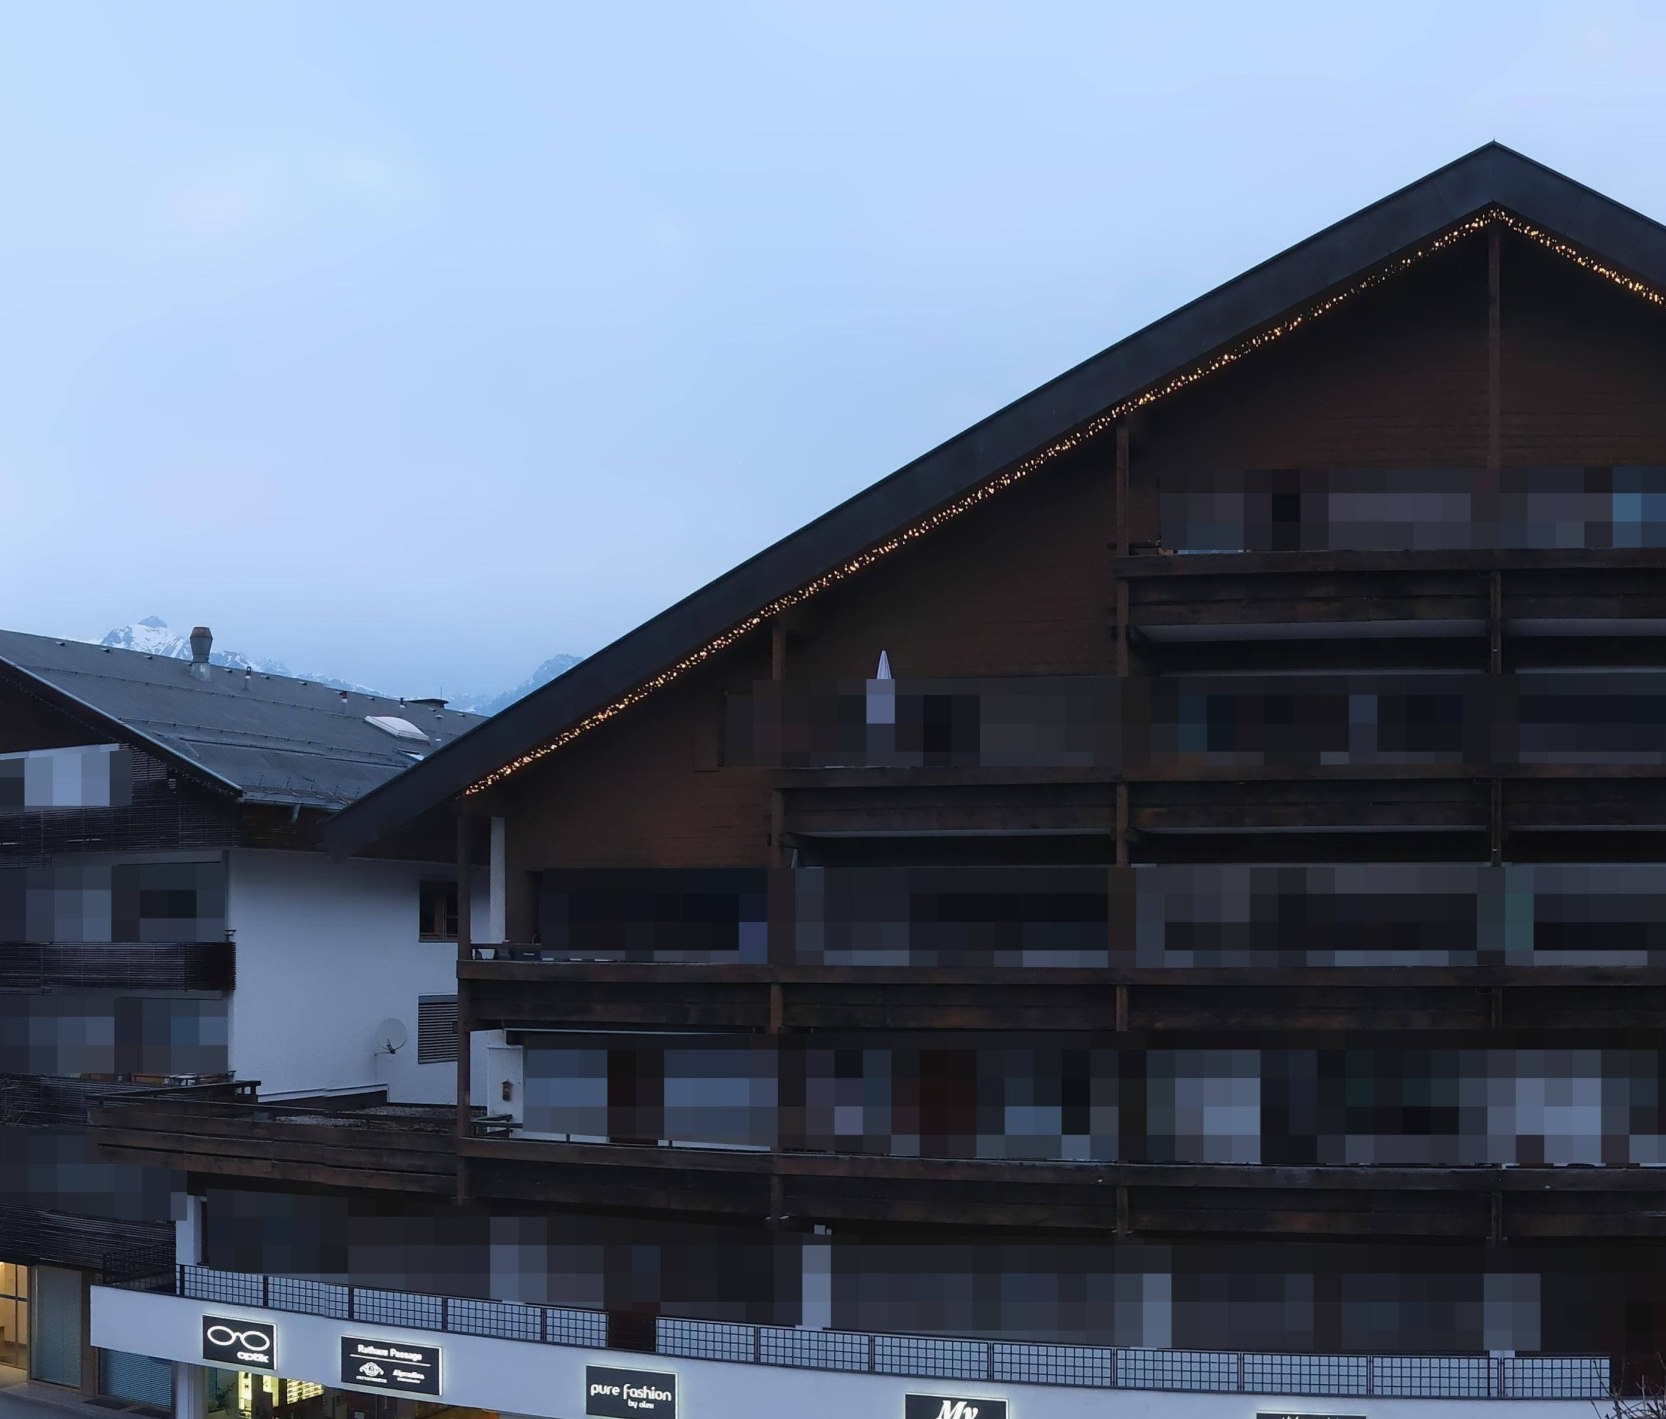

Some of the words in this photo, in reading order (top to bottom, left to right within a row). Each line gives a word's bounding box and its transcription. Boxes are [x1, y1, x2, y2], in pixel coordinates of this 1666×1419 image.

[237, 1351, 269, 1364] optik
[357, 1344, 388, 1356] Rathaus
[390, 1348, 422, 1361] Passage
[590, 1383, 620, 1396] pure
[623, 1384, 672, 1401] fashion
[628, 1400, 637, 1409] by
[638, 1400, 654, 1409] alex
